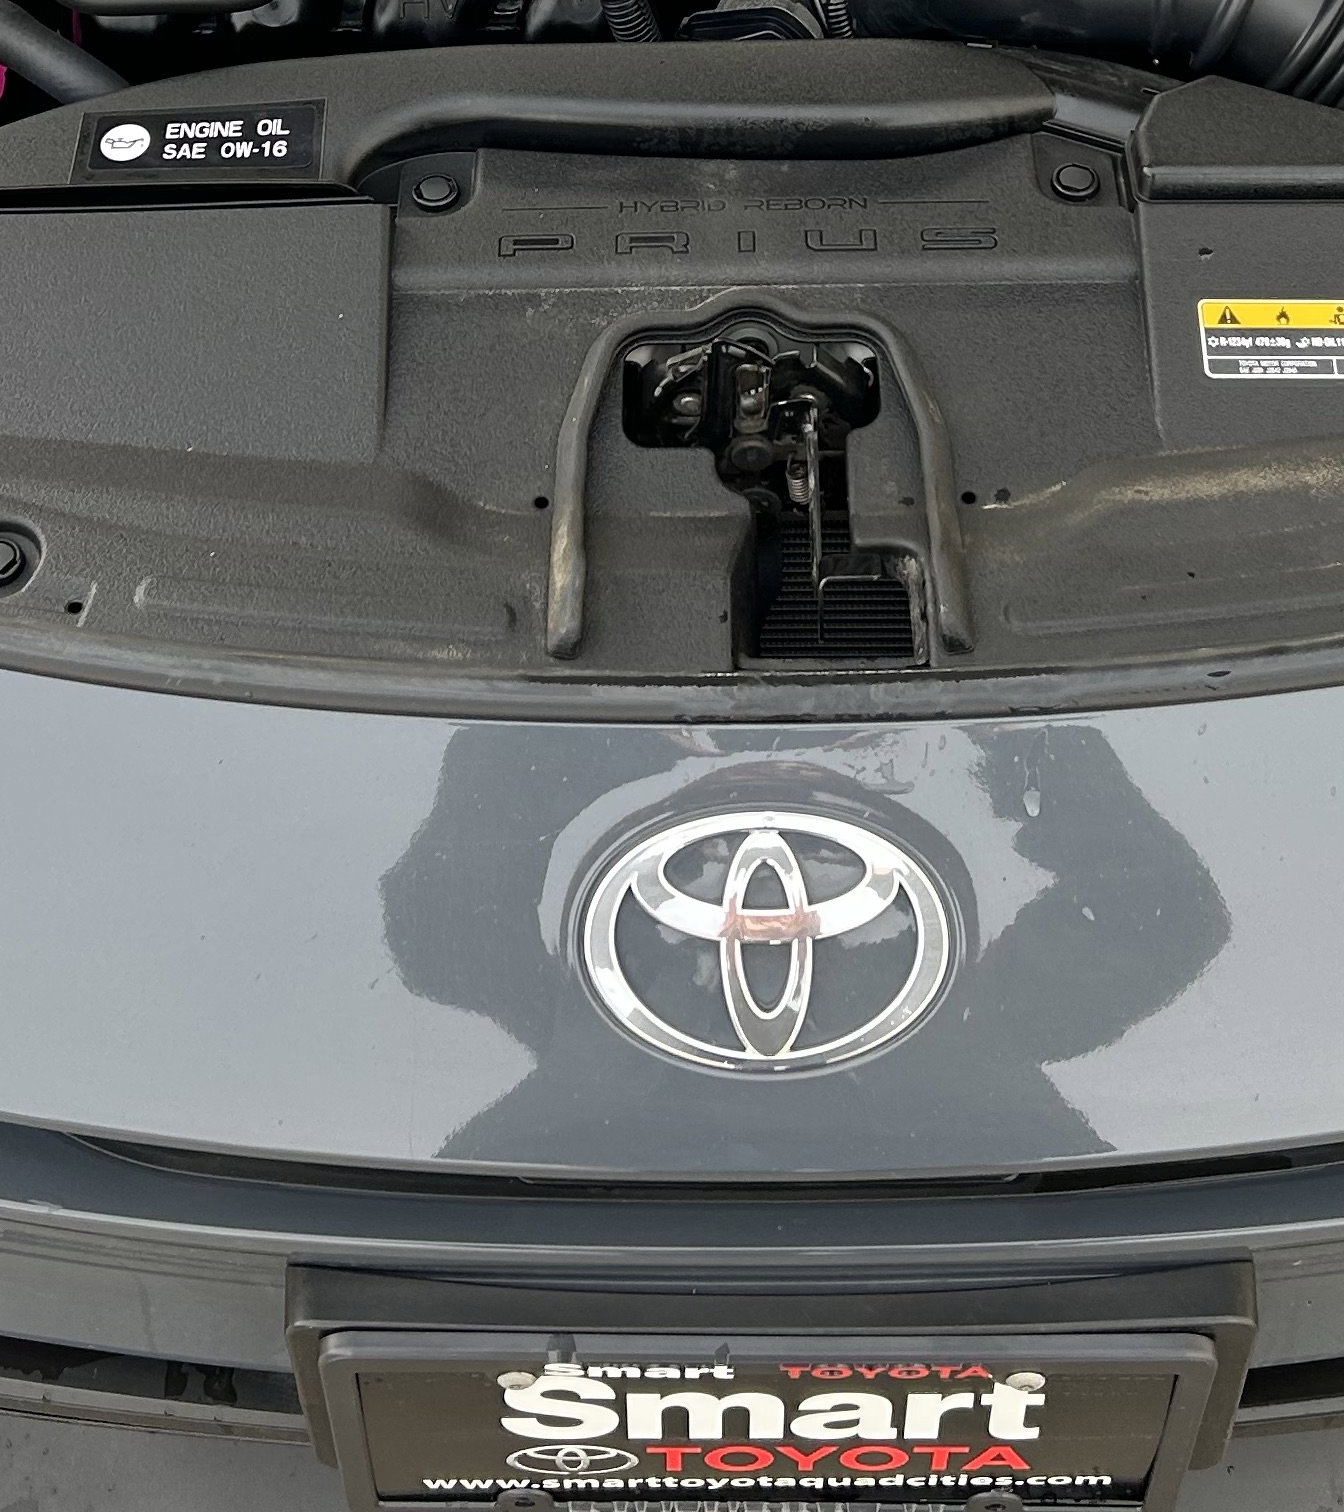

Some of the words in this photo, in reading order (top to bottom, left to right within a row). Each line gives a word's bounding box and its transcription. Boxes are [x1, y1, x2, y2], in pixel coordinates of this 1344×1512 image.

[165, 120, 244, 139] ENGINE
[257, 118, 291, 136] OIL
[162, 143, 207, 159] SAE
[220, 140, 288, 159] 0W-16
[618, 199, 727, 214] HYBRID
[744, 196, 869, 212] REBORN
[497, 226, 999, 258] PRIUS
[544, 1361, 735, 1380] Smart
[779, 1362, 993, 1380] TOYOTA
[500, 1375, 1047, 1440] Smart
[645, 1444, 1032, 1472] TOYOTA
[423, 1473, 1113, 1489] www.smarttoyotaquadcities.com
